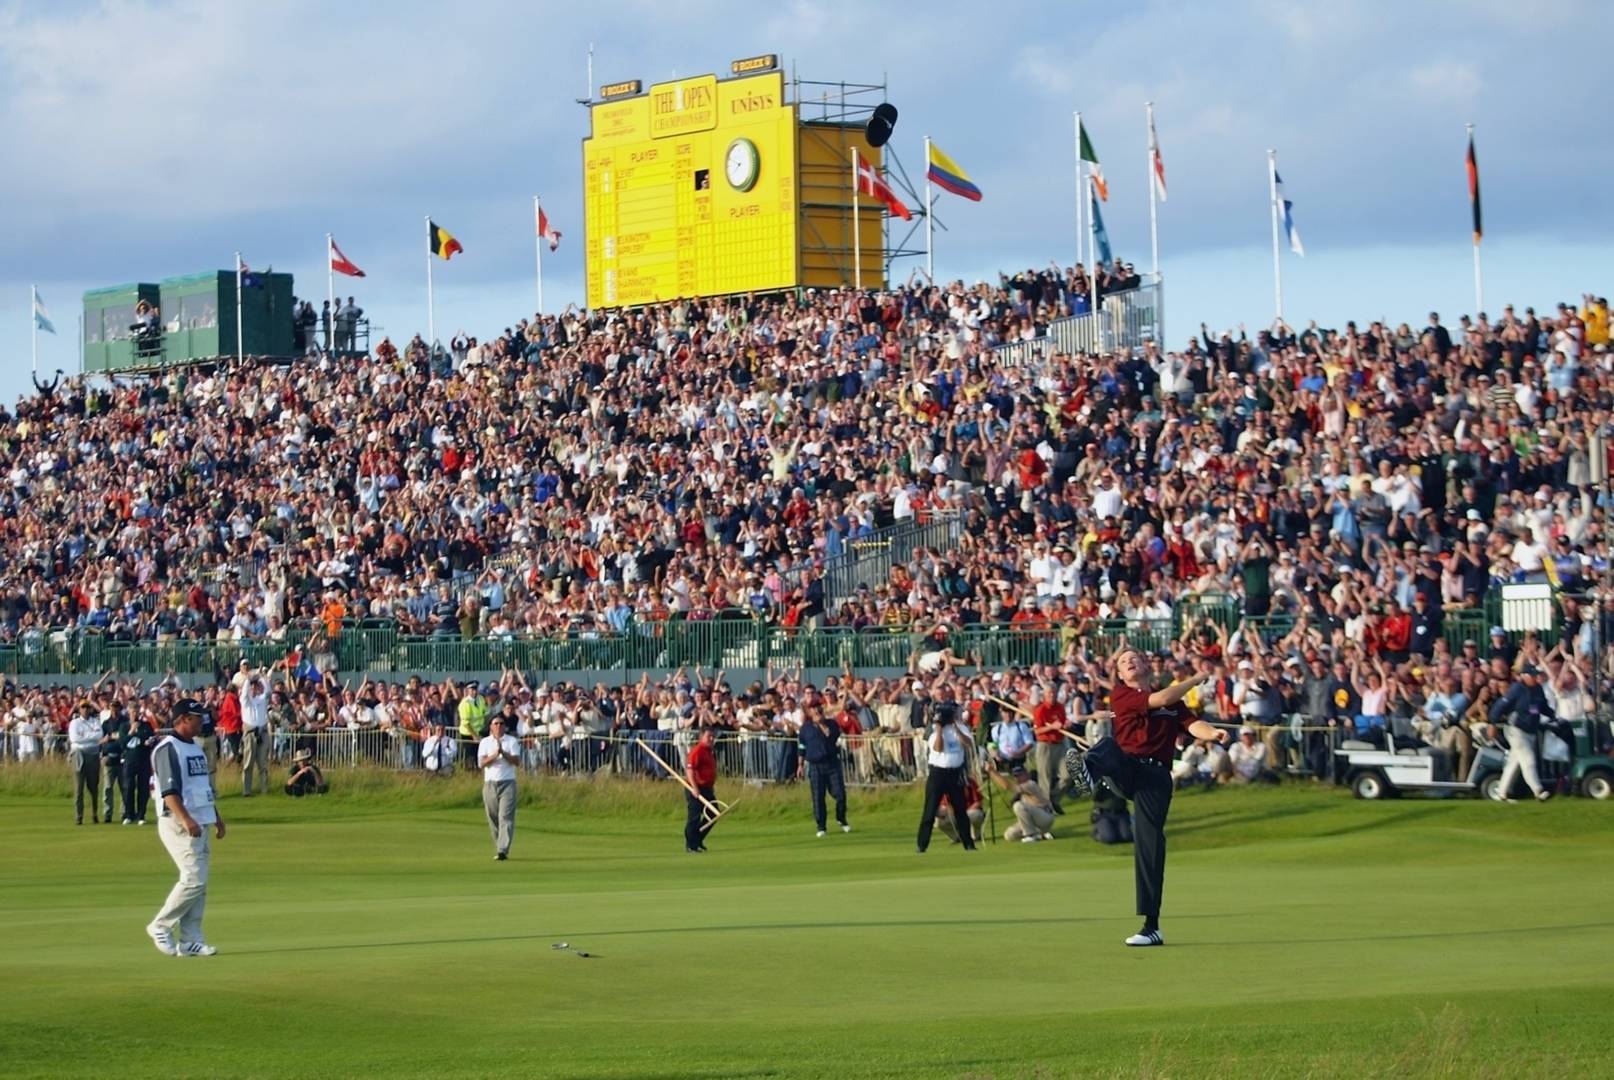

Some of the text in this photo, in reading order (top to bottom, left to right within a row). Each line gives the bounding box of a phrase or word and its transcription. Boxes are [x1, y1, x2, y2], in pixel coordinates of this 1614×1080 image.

[654, 92, 674, 115] THE
[683, 84, 713, 110] OPEN
[631, 149, 657, 162] PLAYER
[730, 204, 760, 218] PLAYER
